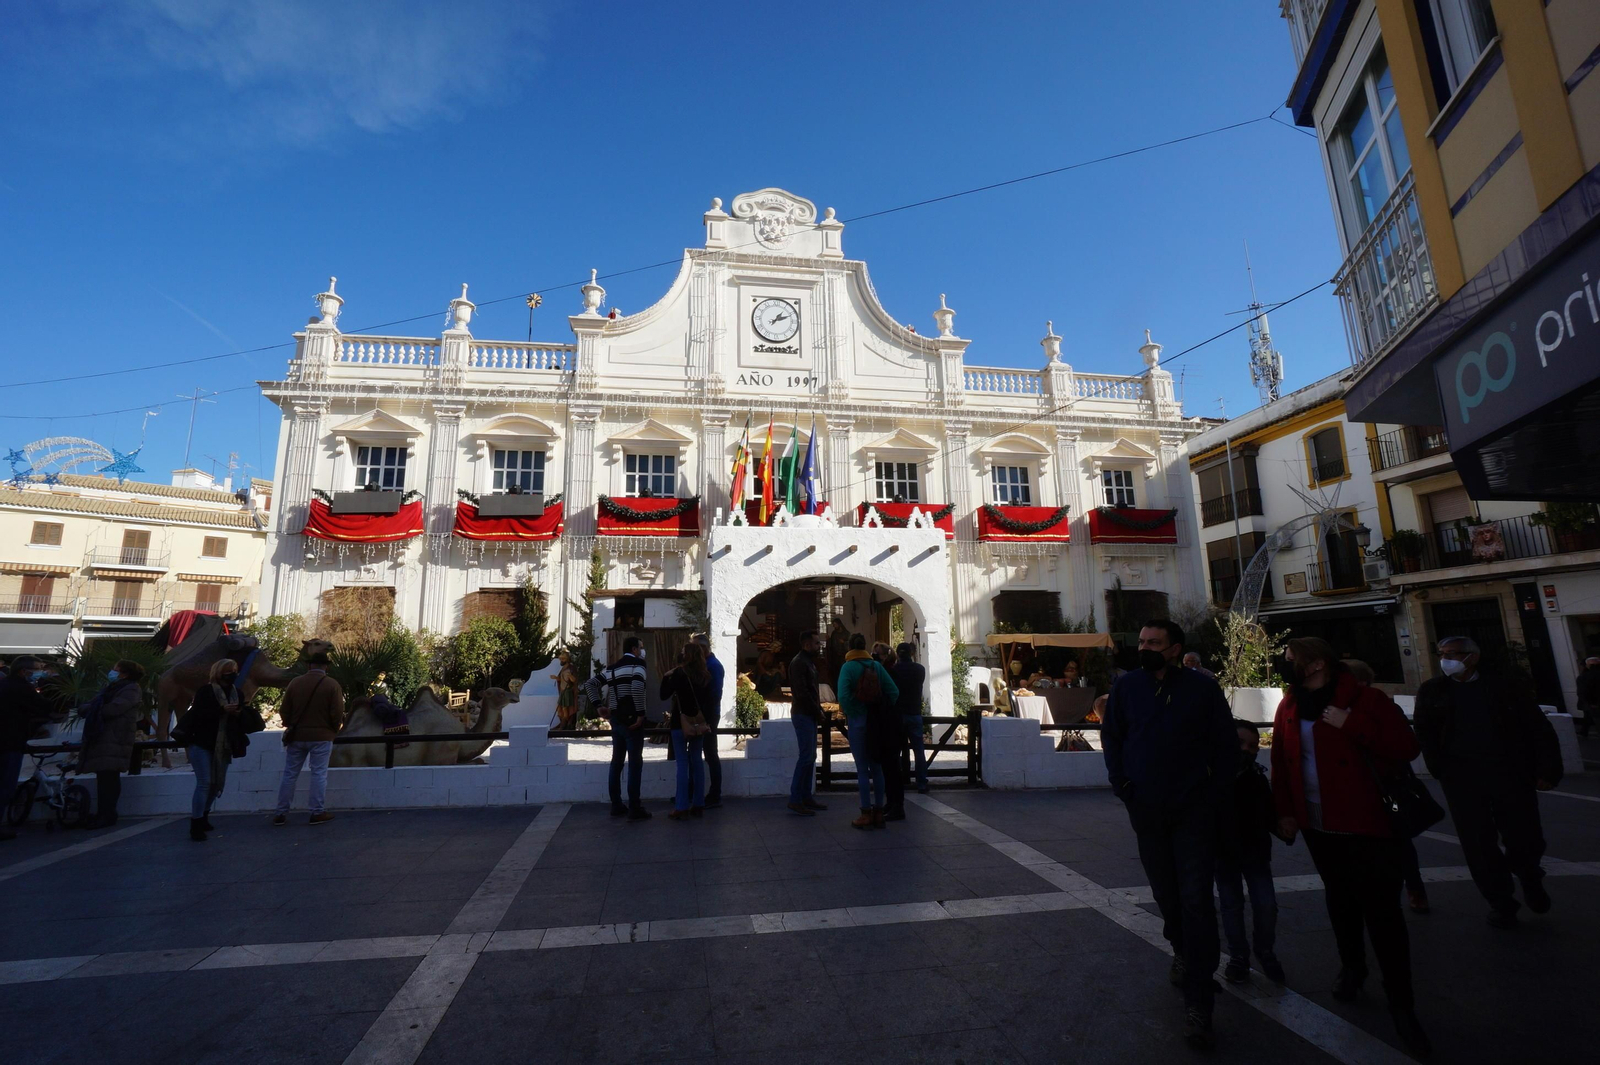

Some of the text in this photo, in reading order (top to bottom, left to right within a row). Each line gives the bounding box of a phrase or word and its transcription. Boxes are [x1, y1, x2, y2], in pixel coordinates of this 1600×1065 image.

[1535, 271, 1600, 368] pri
[736, 371, 818, 389] AÑO 1997
